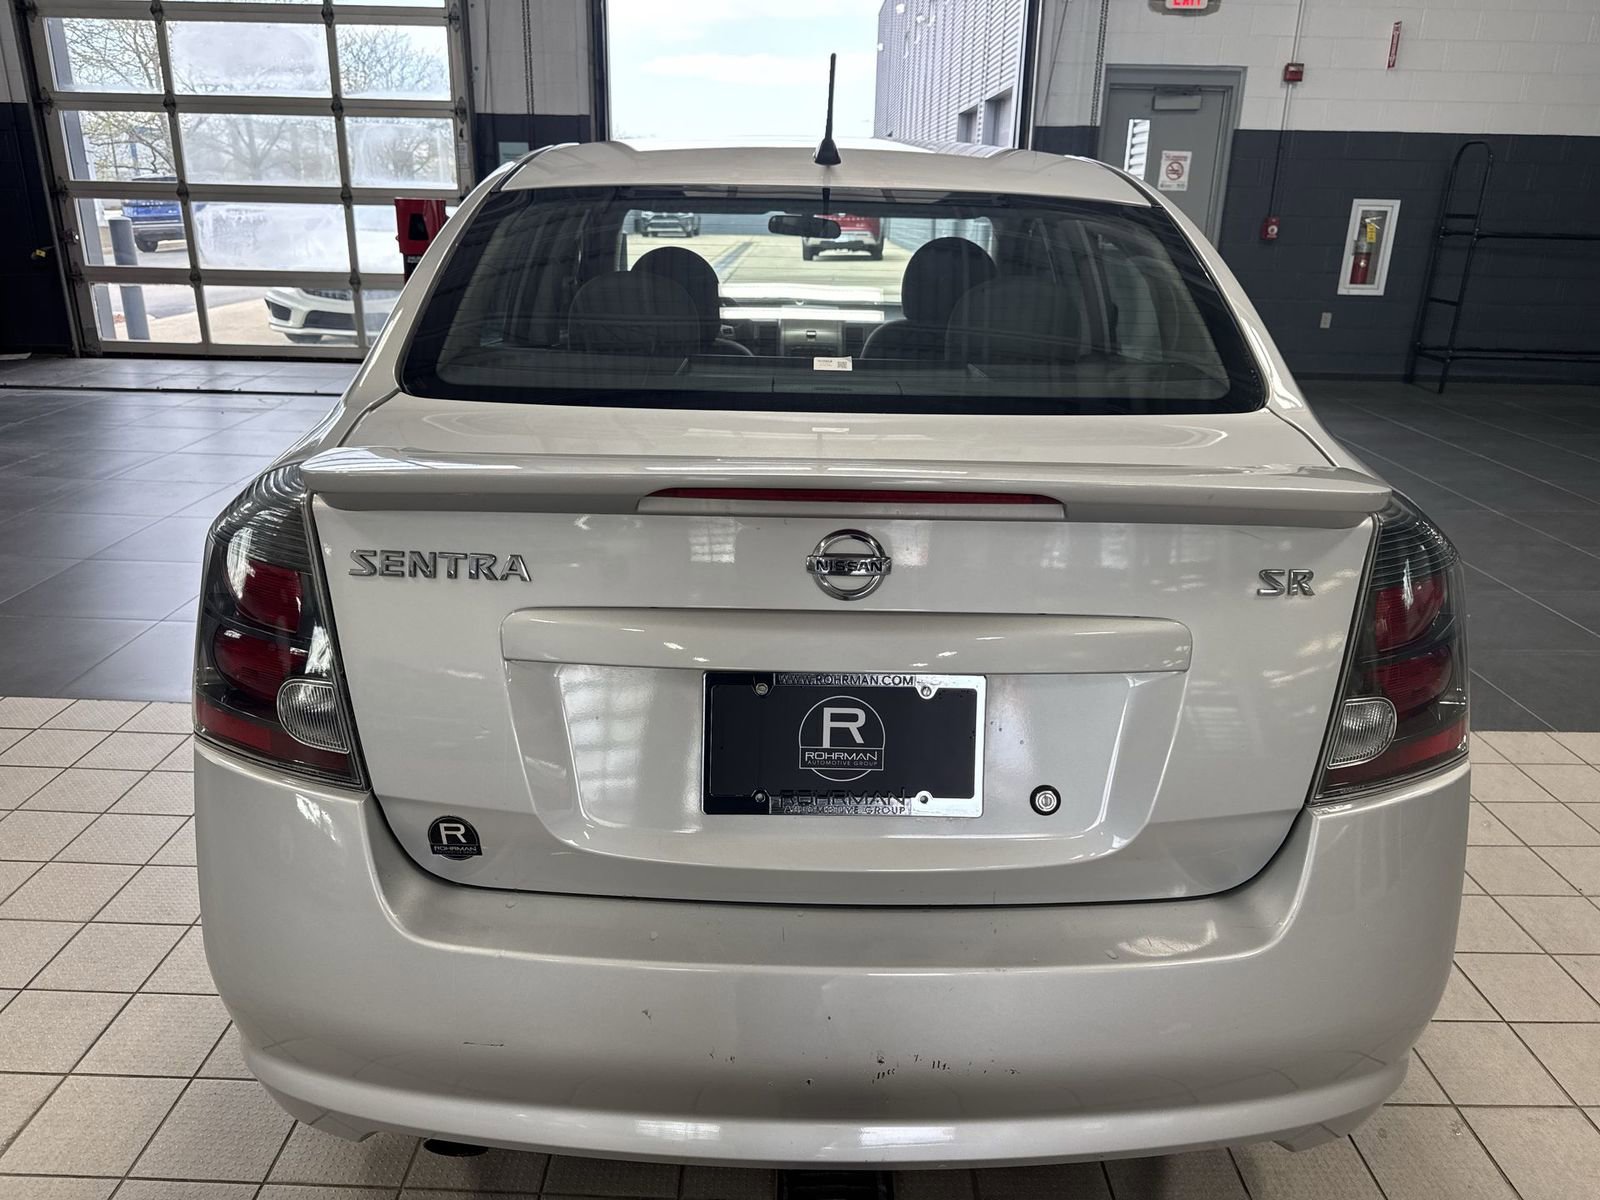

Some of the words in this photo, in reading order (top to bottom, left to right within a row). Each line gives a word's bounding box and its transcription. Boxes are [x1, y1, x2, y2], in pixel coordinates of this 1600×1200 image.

[349, 550, 532, 582] SENTRA
[816, 560, 882, 572] NISSAN
[1257, 569, 1315, 596] SR
[778, 675, 914, 686] WWW.ROHRMAN.COM
[823, 707, 866, 748] R
[805, 751, 878, 761] ROHRMAN
[865, 806, 906, 815] GROUP
[439, 823, 467, 845] R
